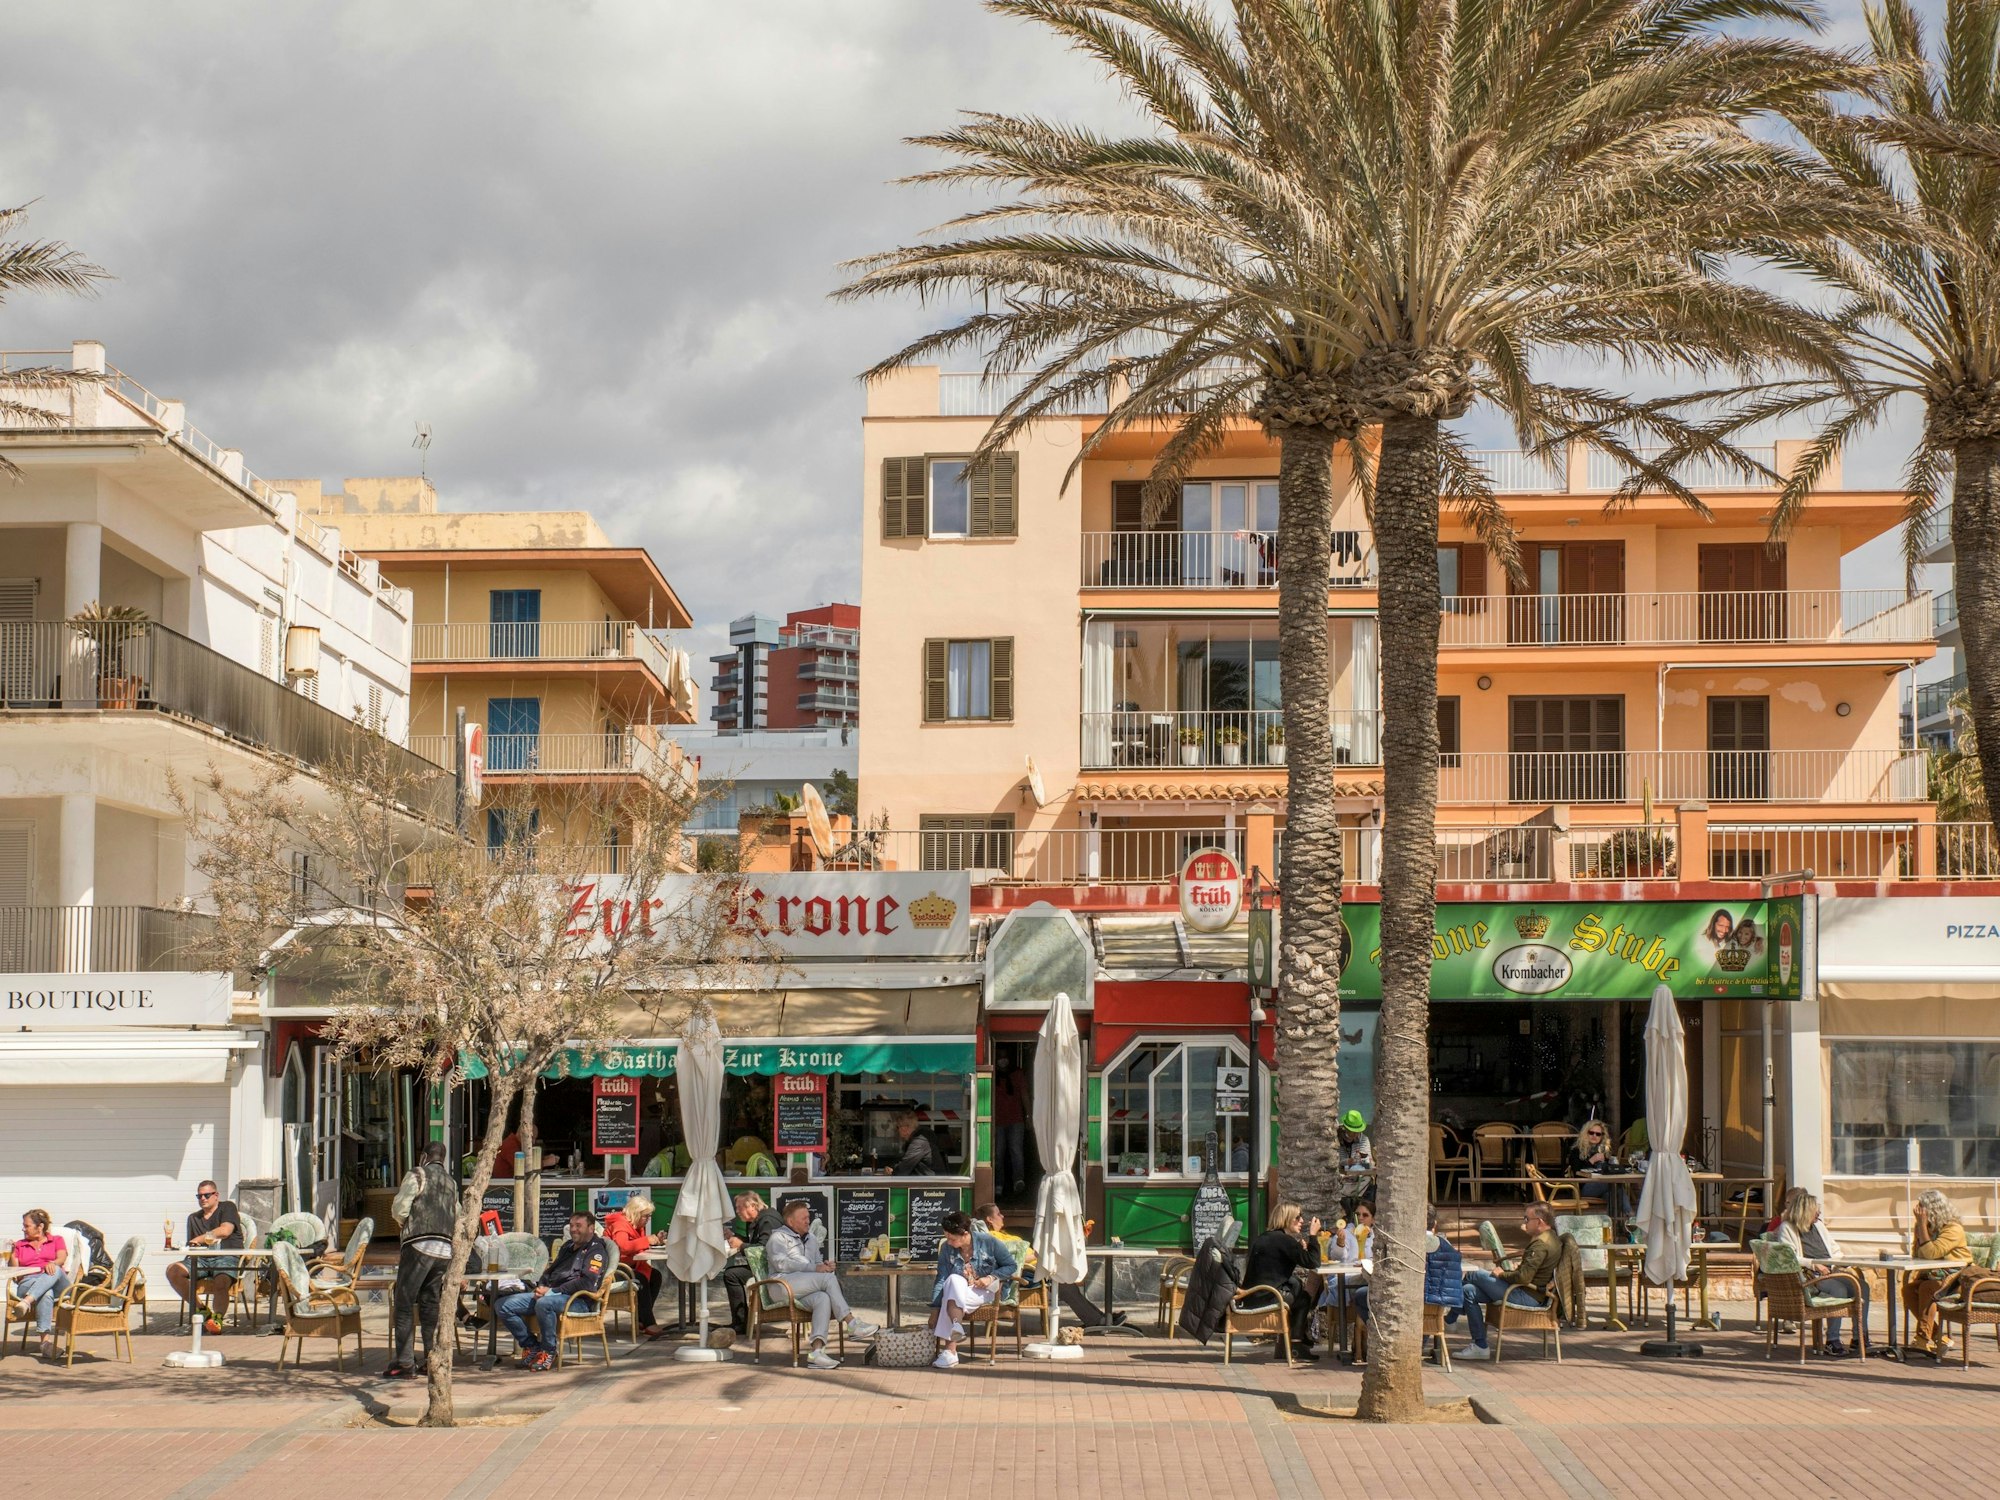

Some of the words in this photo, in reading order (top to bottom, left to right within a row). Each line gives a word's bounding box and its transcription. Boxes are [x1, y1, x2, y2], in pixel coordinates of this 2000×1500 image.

[1190, 884, 1231, 906] früh
[562, 882, 664, 938] Zur
[716, 879, 900, 937] Krone
[1947, 925, 2000, 938] PIZZA
[1569, 913, 1680, 980] Stube
[1502, 964, 1566, 980] Krombacher
[1708, 977, 1734, 985] Beatrice
[8, 990, 154, 1011] BOUTIQUE
[604, 1050, 677, 1071] Gastha
[724, 1048, 762, 1068] Zur
[779, 1047, 844, 1068] Krone
[600, 1077, 628, 1093] früh
[783, 1075, 814, 1092] früh
